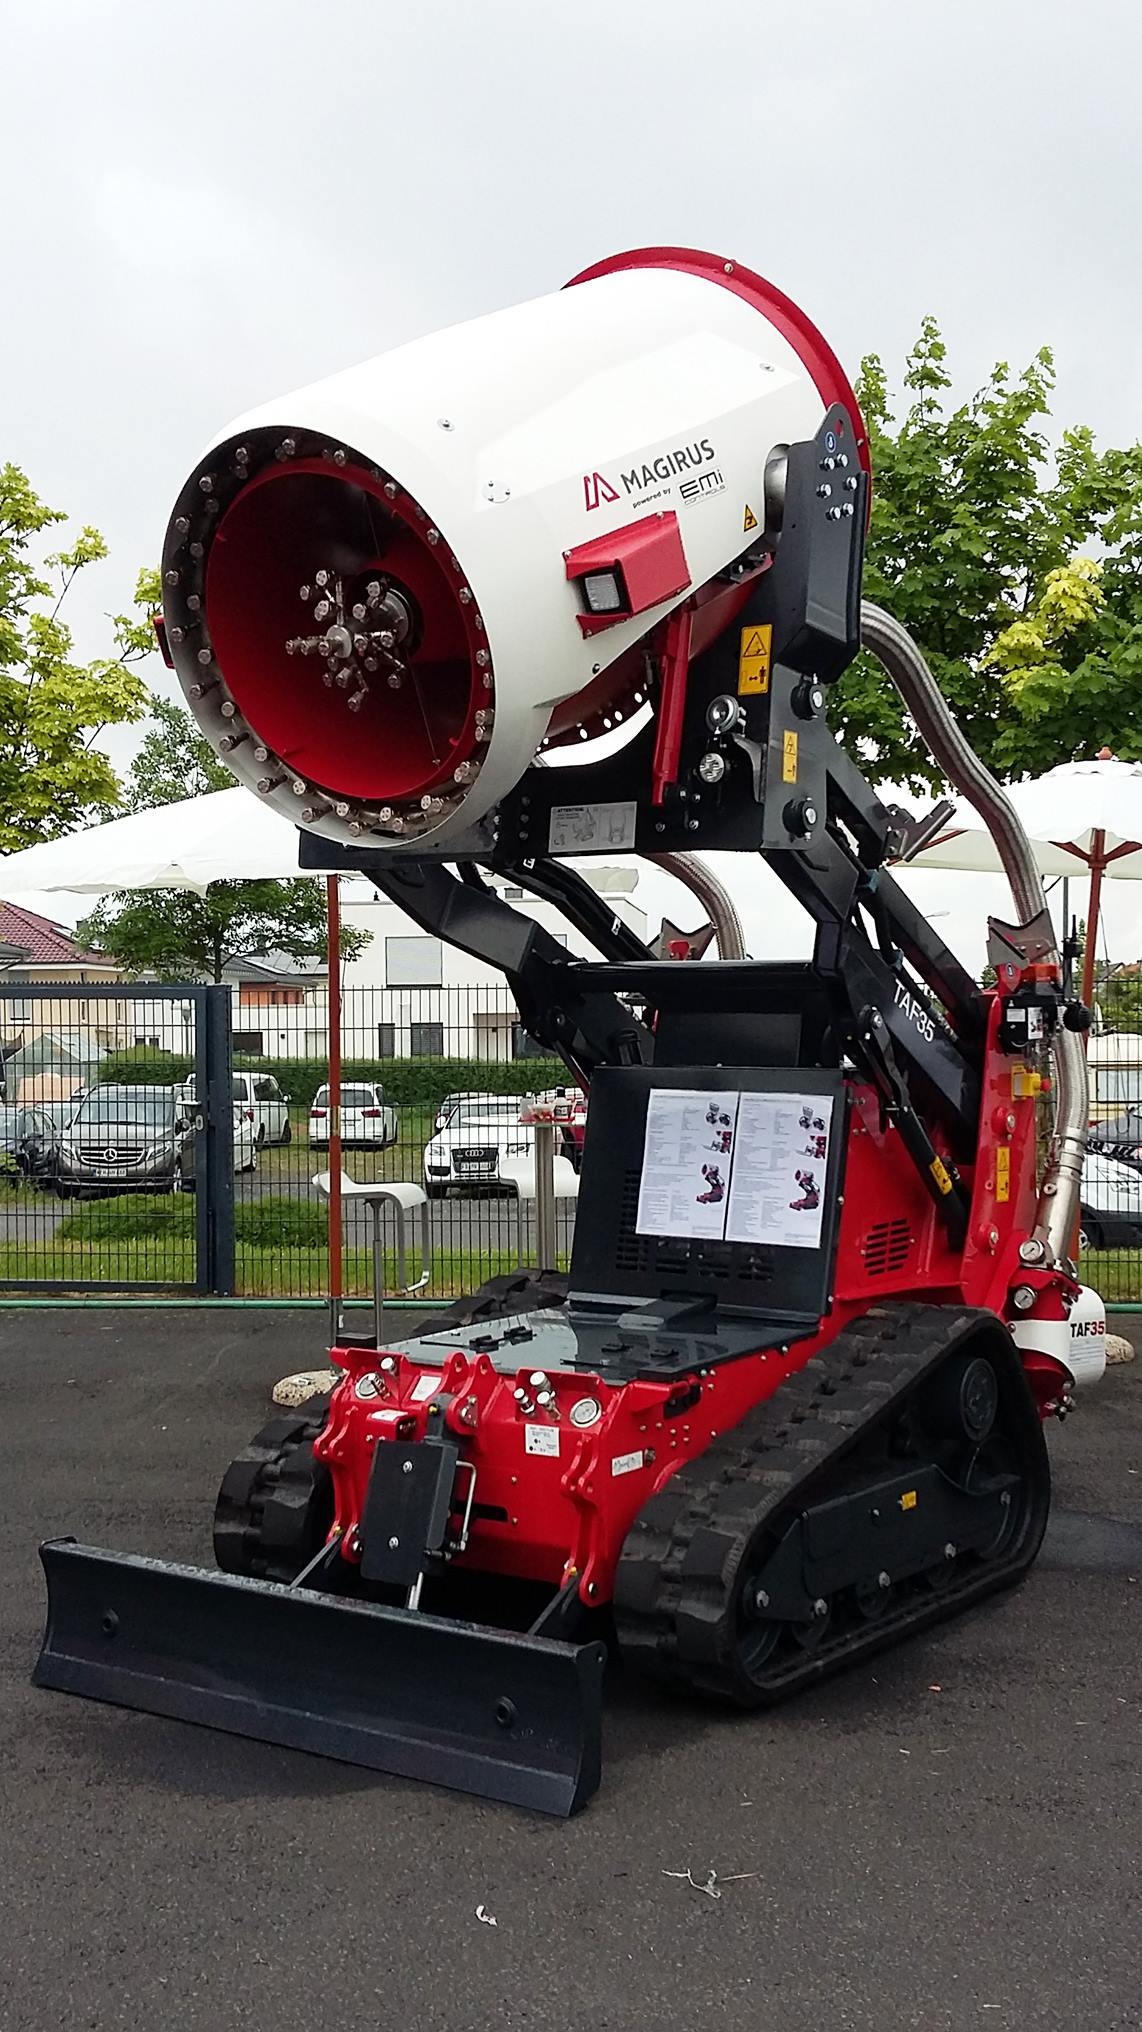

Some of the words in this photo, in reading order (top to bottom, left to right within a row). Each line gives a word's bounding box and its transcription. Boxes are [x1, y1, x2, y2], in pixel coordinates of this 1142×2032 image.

[620, 439, 715, 494] MAGIRUS
[632, 491, 661, 509] powered
[663, 488, 671, 496] by
[894, 978, 935, 1042] TAF35
[1070, 1321, 1104, 1338] TAF35
